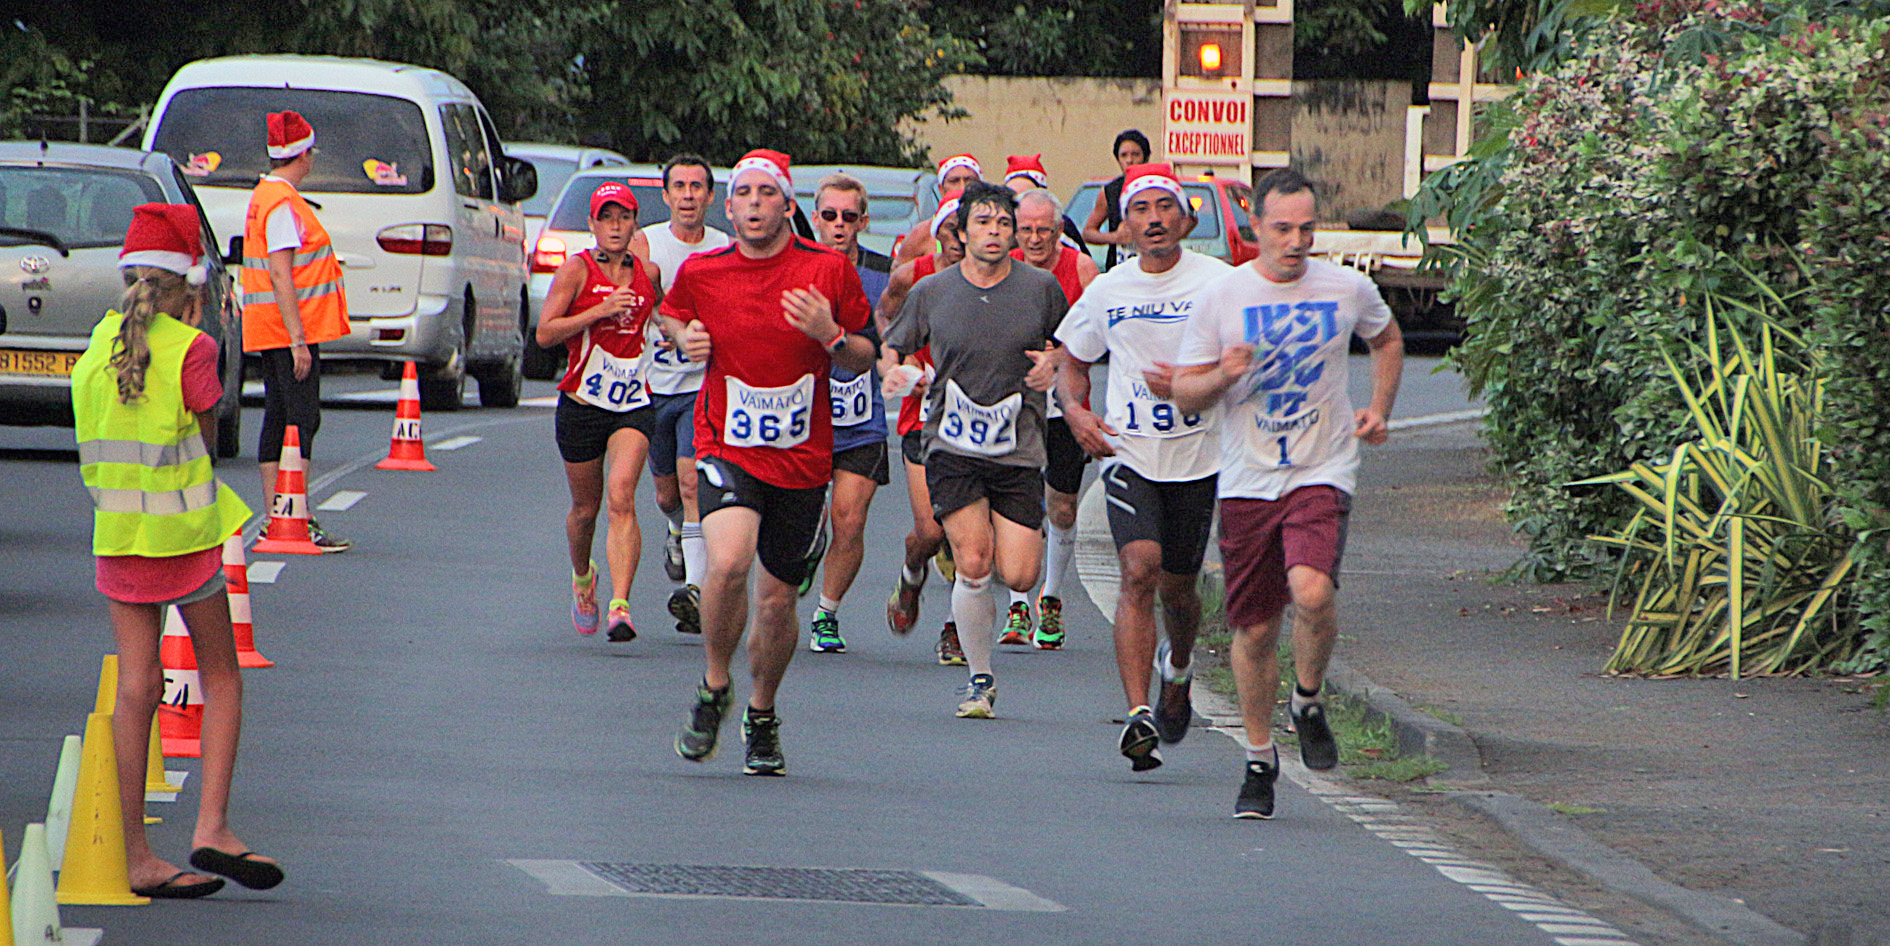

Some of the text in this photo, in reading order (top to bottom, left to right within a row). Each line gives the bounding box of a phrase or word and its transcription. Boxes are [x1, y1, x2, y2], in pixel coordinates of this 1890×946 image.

[1170, 98, 1246, 124] CONVOI
[1168, 131, 1246, 157] EXCEPTIONNEL
[1131, 302, 1166, 316] NIU
[586, 372, 643, 405] 402
[739, 388, 804, 410] VAIMATO
[956, 396, 1011, 421] VAIMATO
[731, 406, 808, 442] 365
[944, 410, 1011, 444] 392
[1276, 435, 1292, 466] 1
